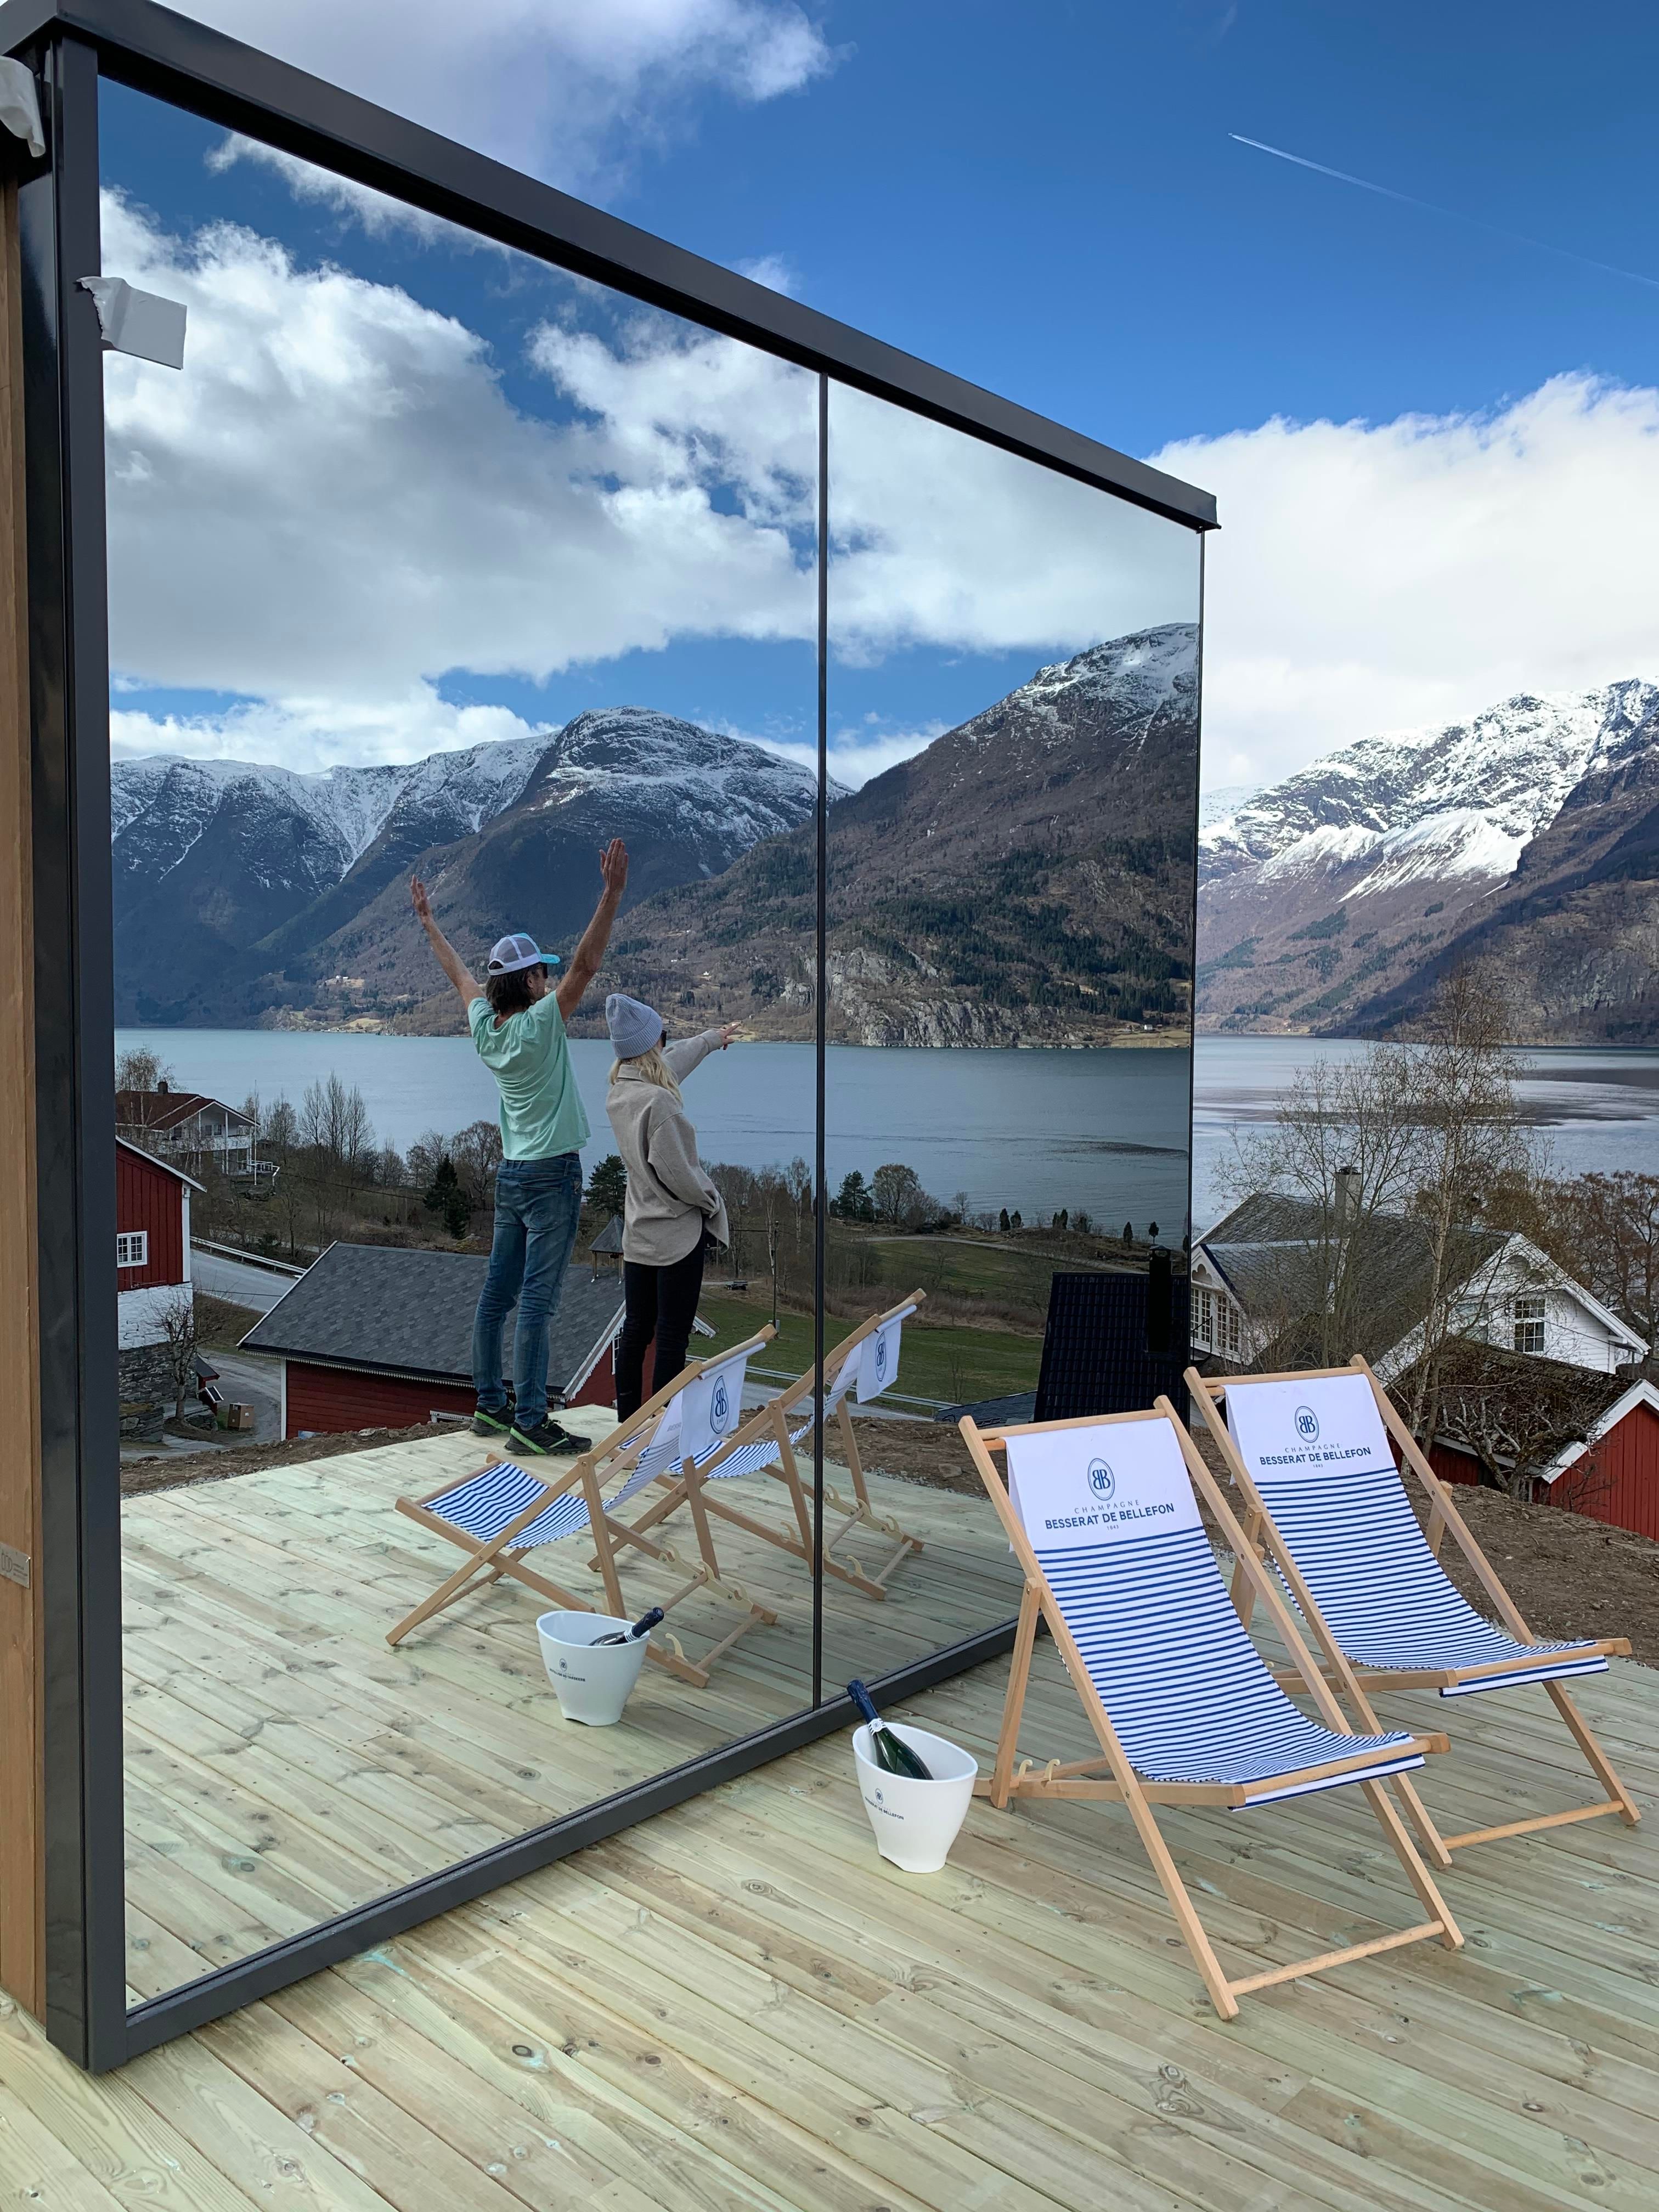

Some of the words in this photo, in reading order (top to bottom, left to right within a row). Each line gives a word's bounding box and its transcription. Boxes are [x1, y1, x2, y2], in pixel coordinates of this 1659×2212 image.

[1260, 1454, 1306, 1465] BESSERAT
[1310, 1453, 1322, 1462] DE
[1323, 1447, 1372, 1461] BELLEFON
[1285, 1443, 1341, 1453] CHAMPAGNE
[1074, 1499, 1139, 1514] CHAMPAGNE
[1045, 1514, 1099, 1530] BESSERAT
[1102, 1512, 1118, 1523] DE
[1119, 1503, 1175, 1521] BELLEFON
